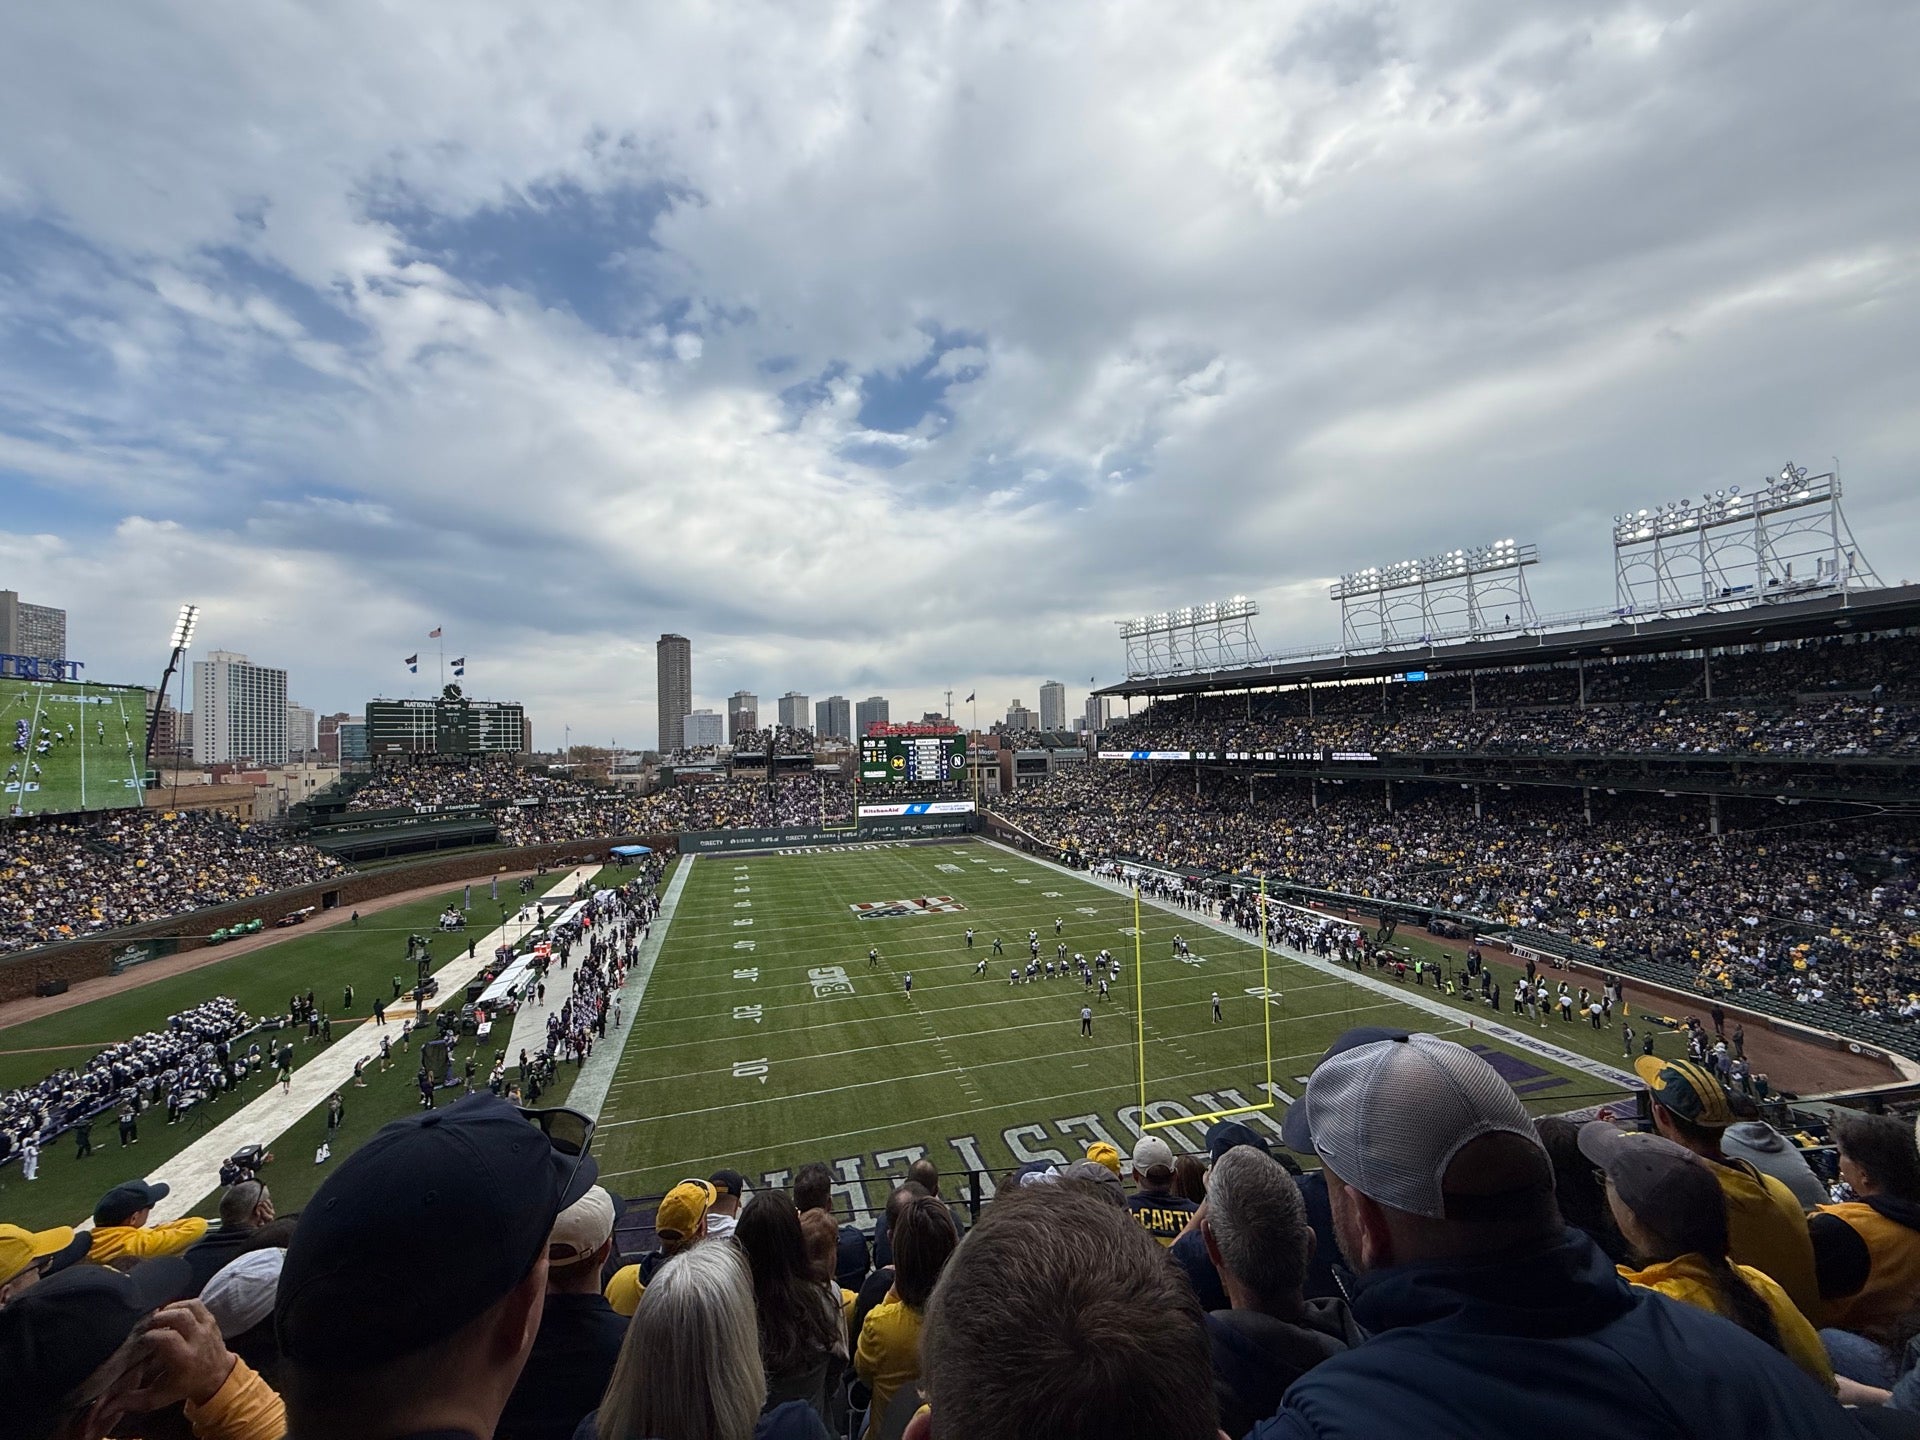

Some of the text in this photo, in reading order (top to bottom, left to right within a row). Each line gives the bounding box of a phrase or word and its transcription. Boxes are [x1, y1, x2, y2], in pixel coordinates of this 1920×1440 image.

[0, 654, 85, 681] TRUST
[403, 701, 437, 709] NATIONAL
[547, 796, 586, 804] Budweiser
[413, 805, 437, 814] YETI
[449, 803, 480, 811] tastytrade
[700, 839, 723, 847] DIRECTV
[778, 843, 911, 856] WILDCATS
[114, 950, 149, 963] Gallagher
[733, 967, 759, 979] 30
[733, 1004, 763, 1019] 20
[733, 1057, 768, 1077] 10
